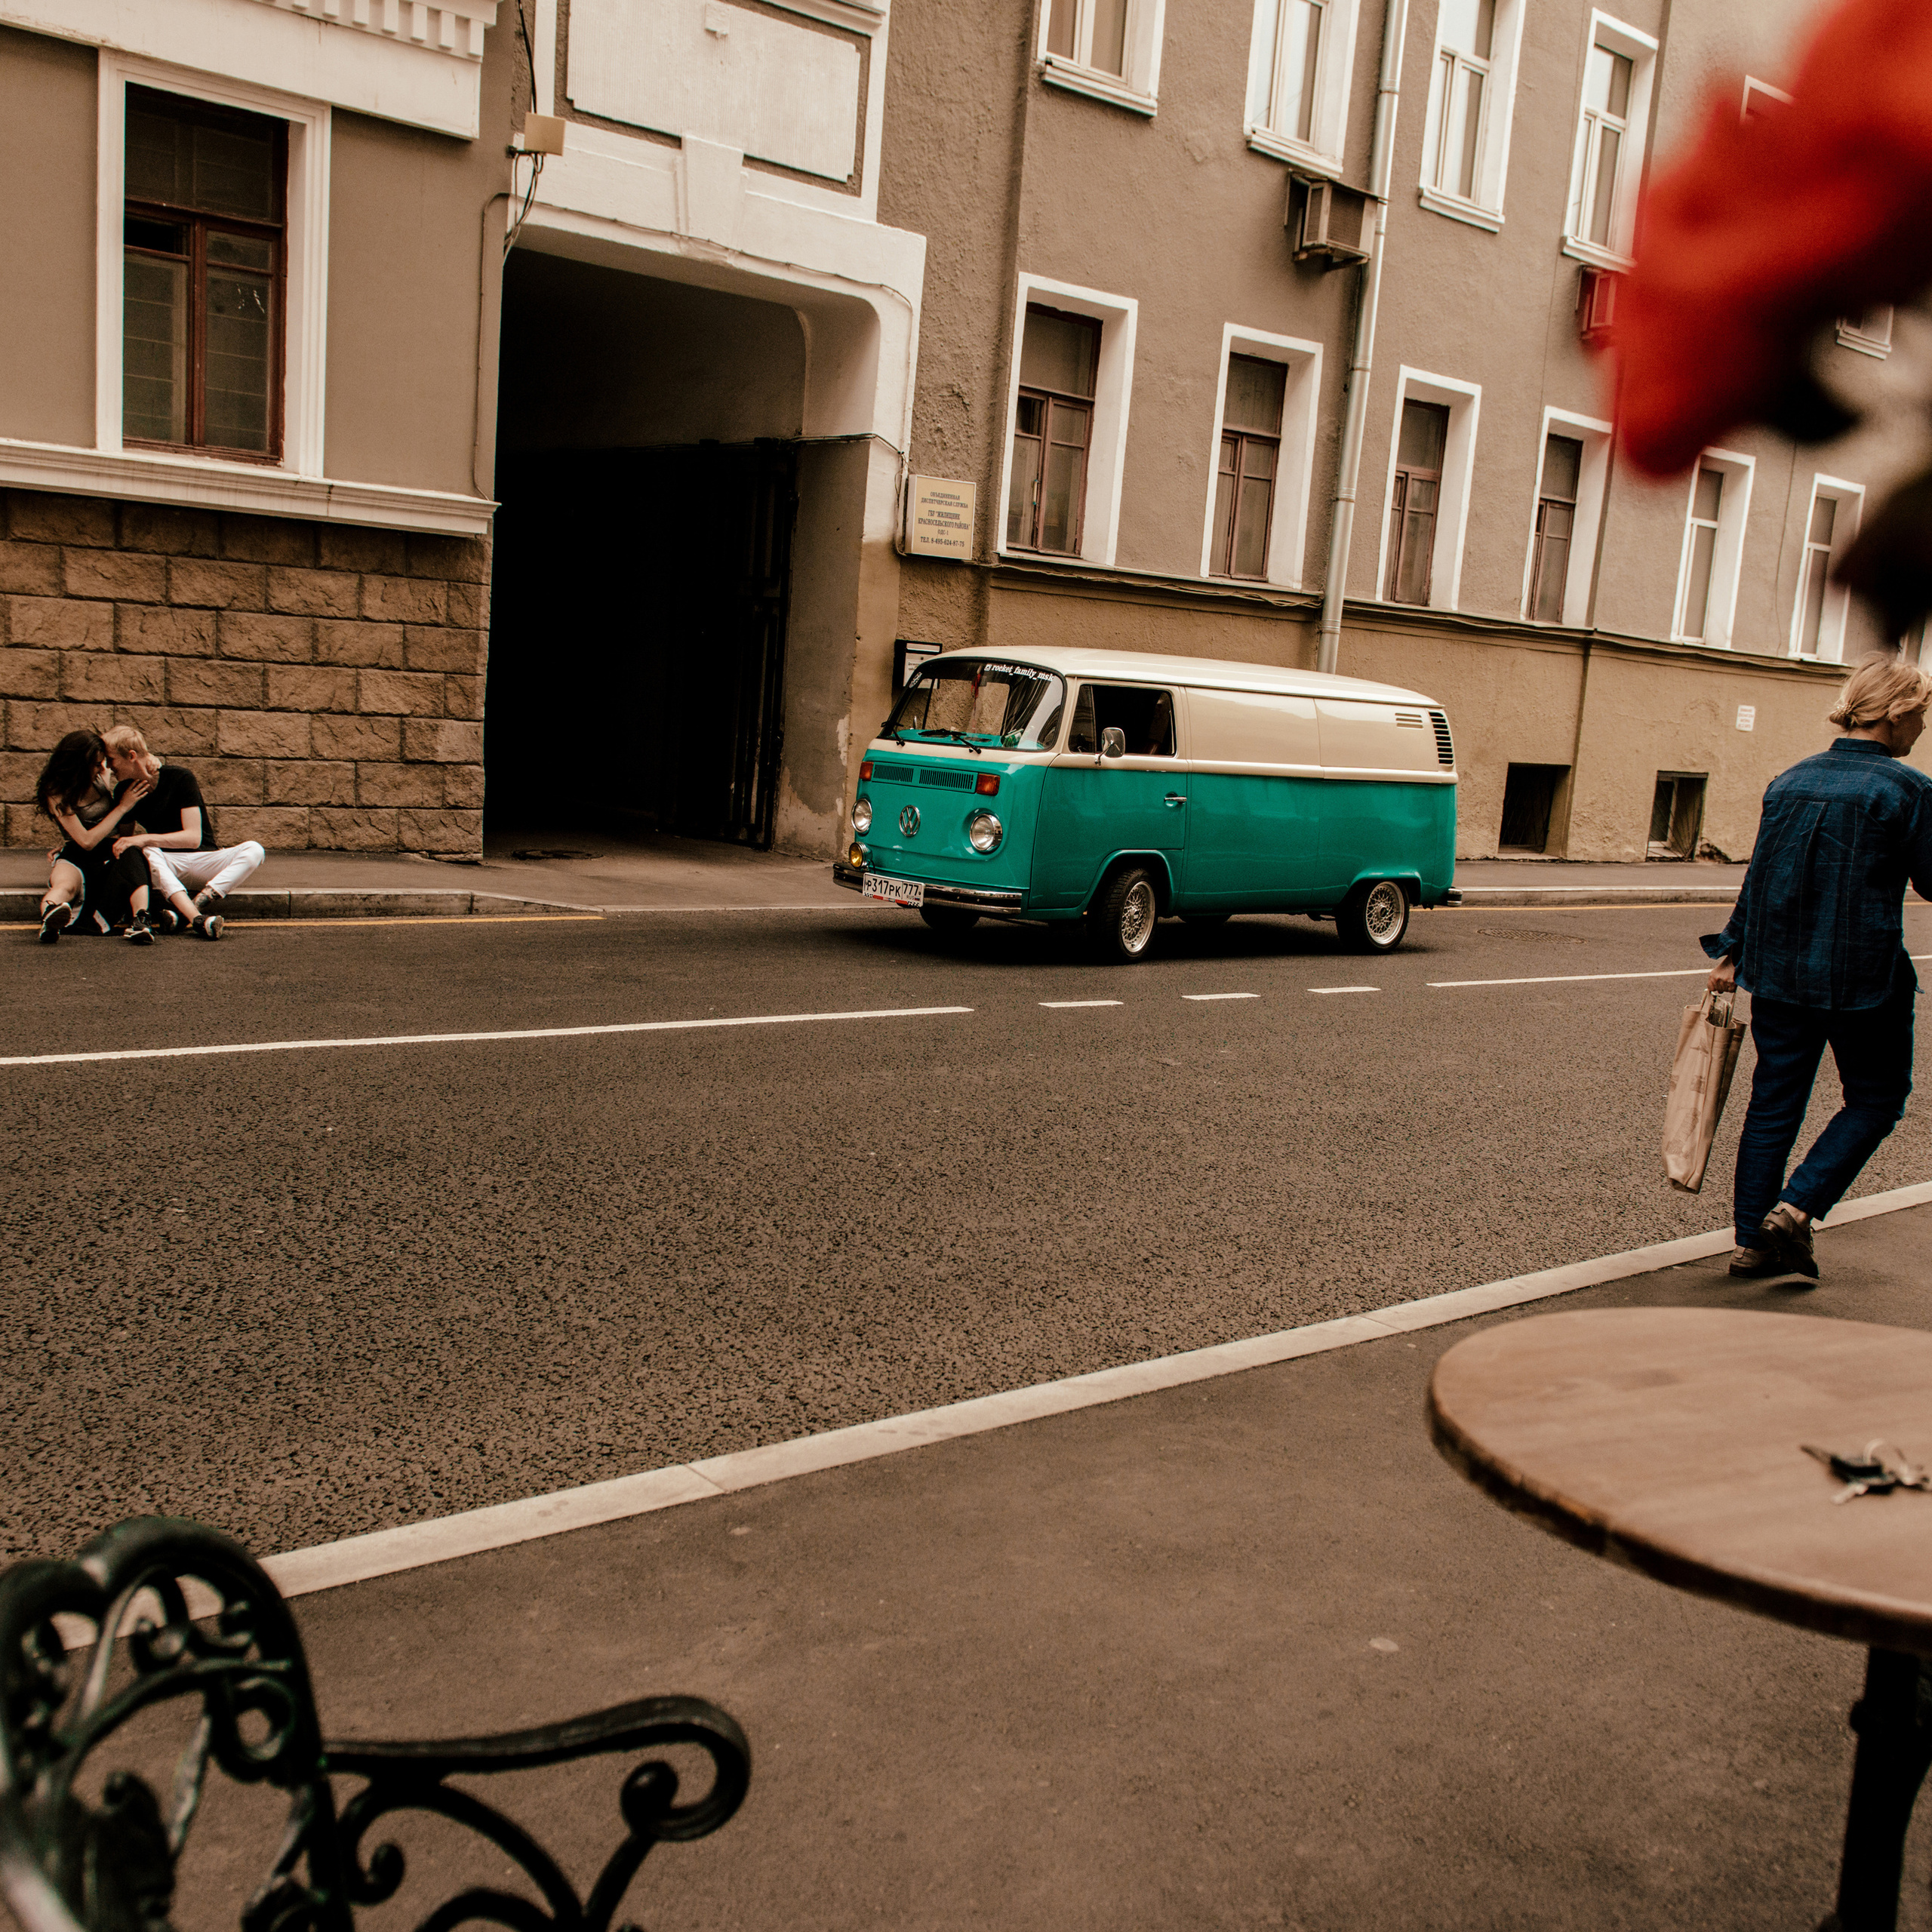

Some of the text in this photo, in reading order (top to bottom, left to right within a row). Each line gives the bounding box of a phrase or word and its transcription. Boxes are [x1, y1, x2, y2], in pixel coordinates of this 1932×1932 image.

[921, 497, 952, 506] ДИСПЕТЧЕРСКАЯ
[918, 518, 954, 528] КРАСНОСЕЛЬСКОГО
[992, 664, 1054, 681] rocket_family_msk
[900, 805, 920, 836] VW
[903, 883, 918, 896] 777
